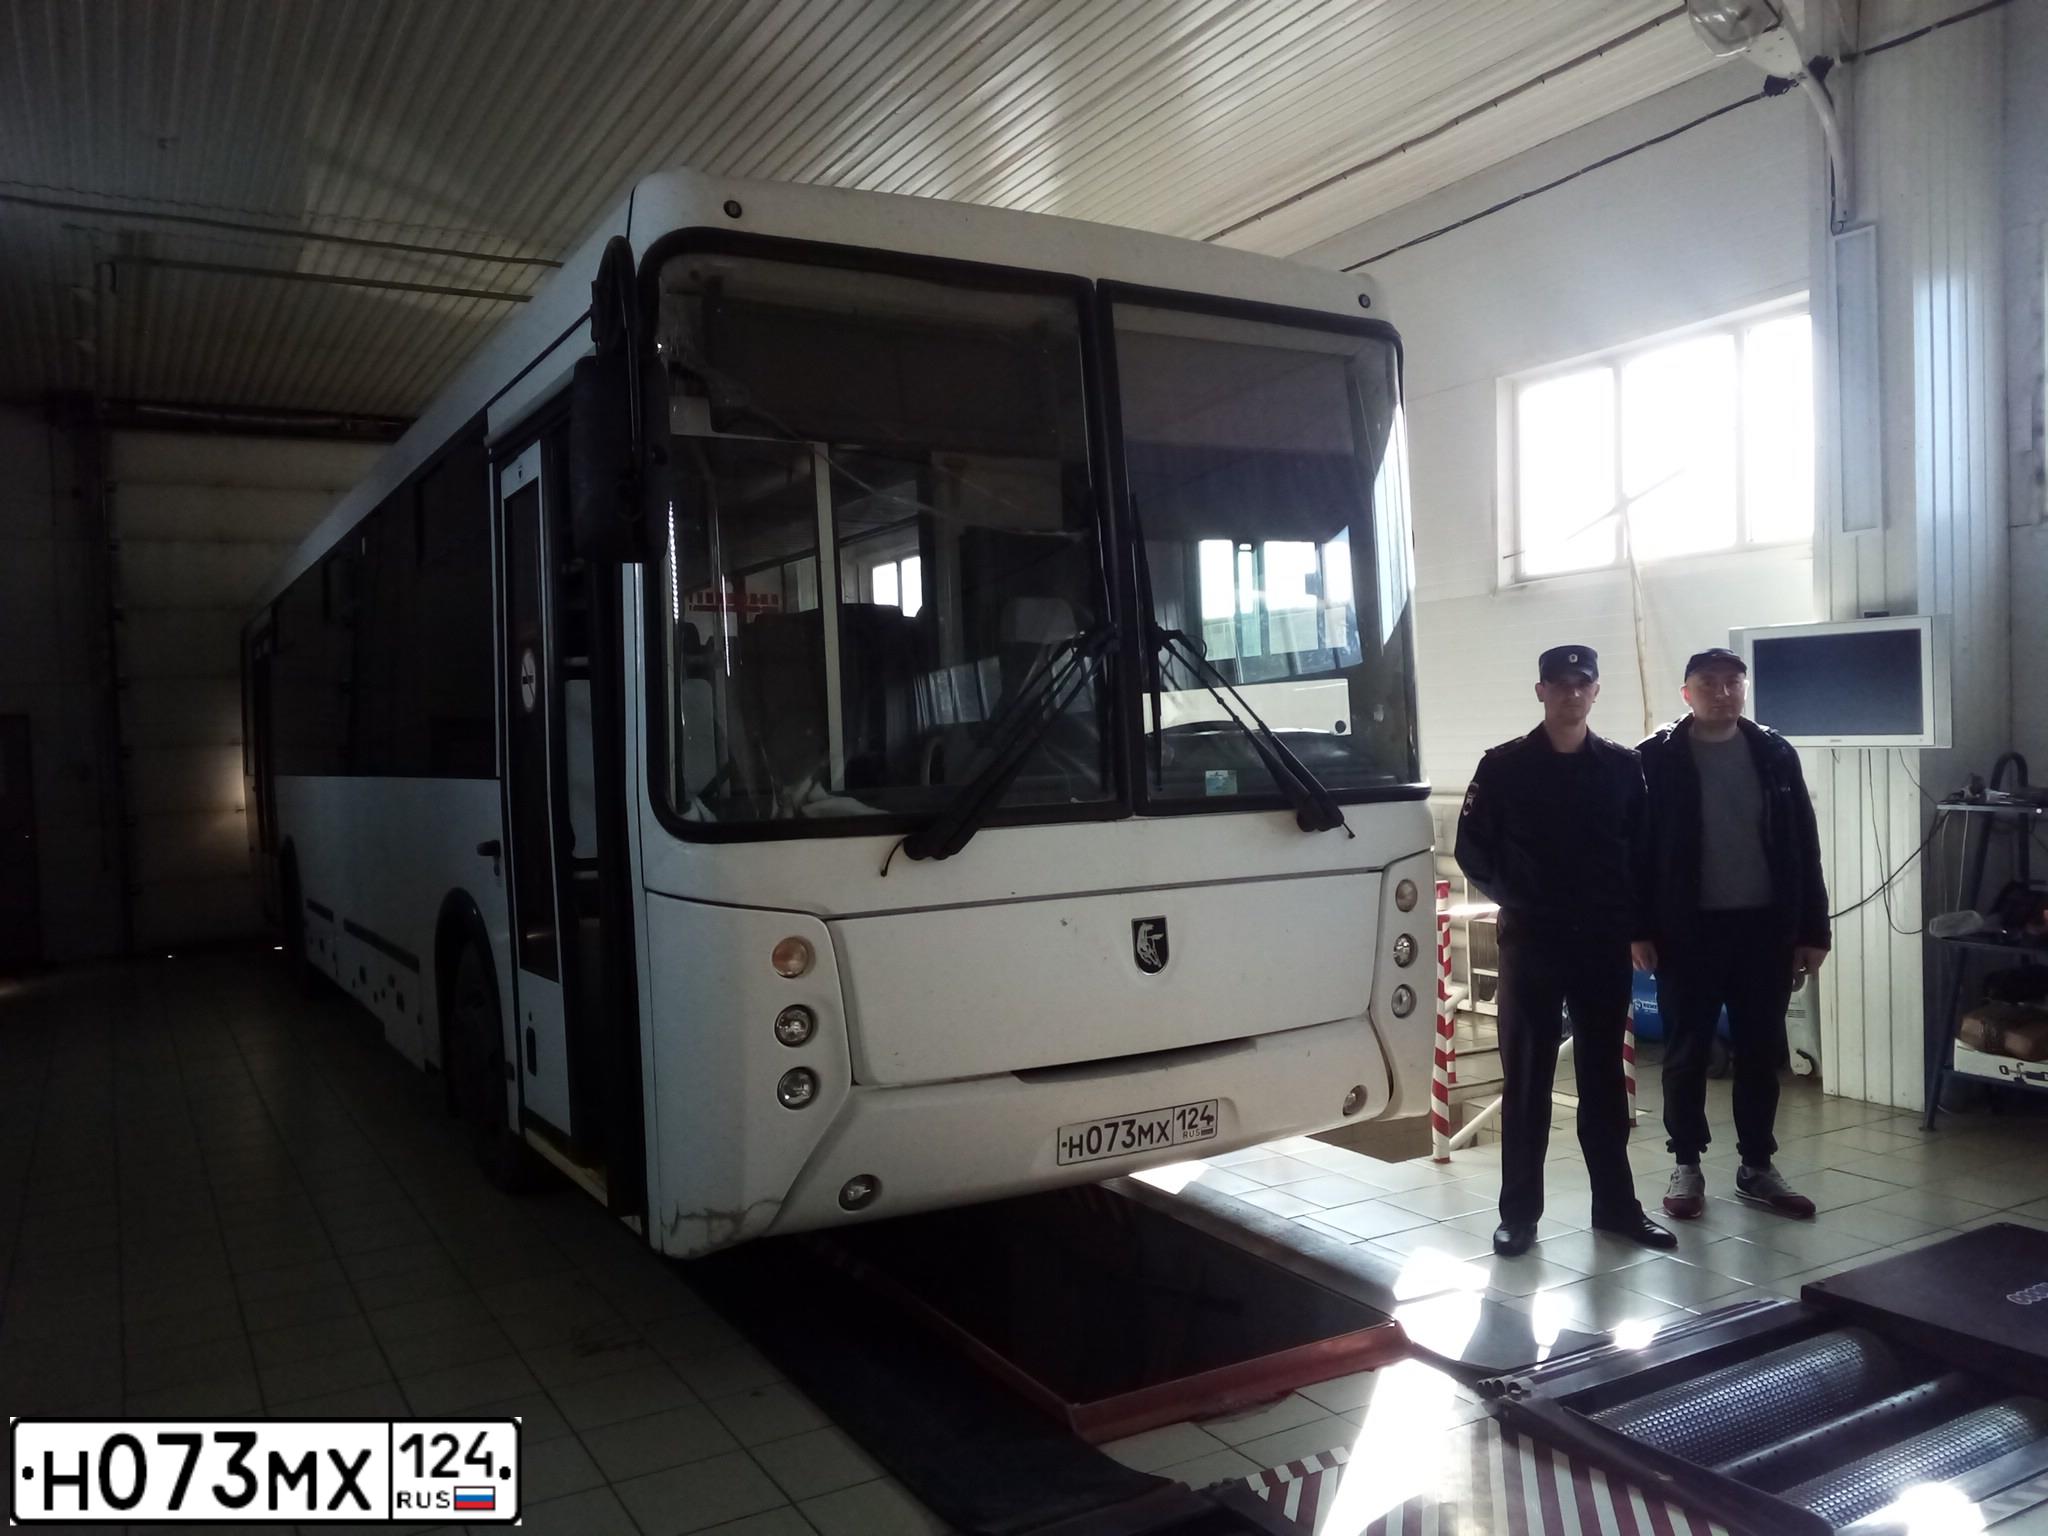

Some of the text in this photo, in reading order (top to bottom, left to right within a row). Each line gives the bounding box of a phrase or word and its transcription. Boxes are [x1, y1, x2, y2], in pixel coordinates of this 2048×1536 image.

[1068, 1105, 1214, 1158] Н073МХ 124
[1182, 1129, 1201, 1139] RUS
